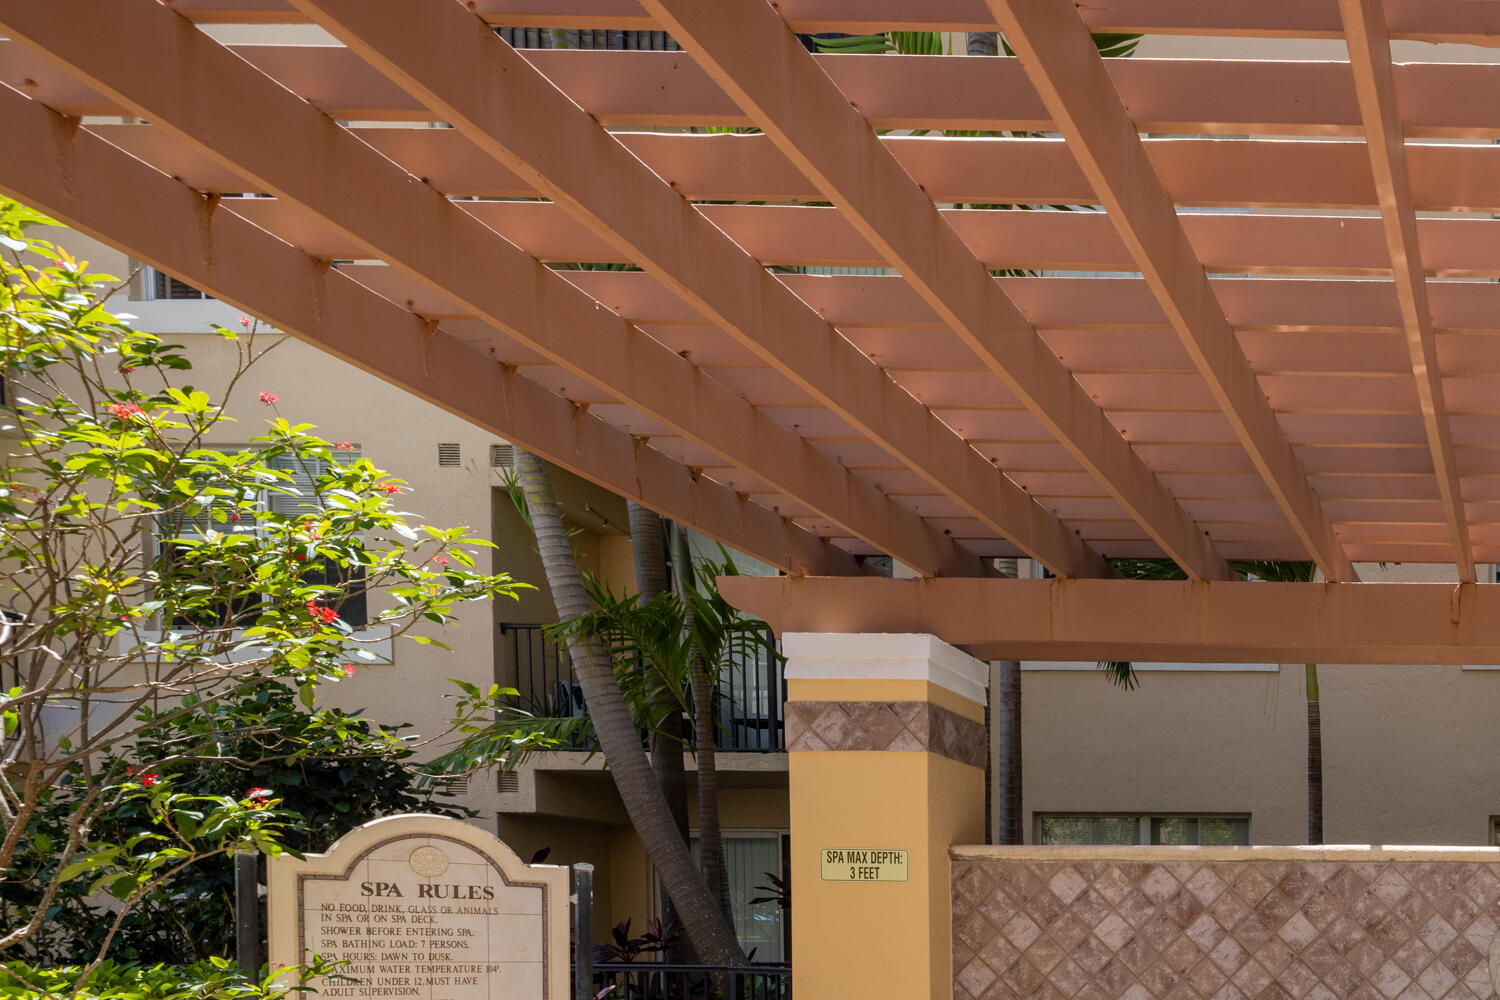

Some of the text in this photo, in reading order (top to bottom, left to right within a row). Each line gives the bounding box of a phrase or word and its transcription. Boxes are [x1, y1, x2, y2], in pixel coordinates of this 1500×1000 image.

[826, 850, 902, 864] SPA MAX DEPTH:
[850, 866, 880, 880] 3 FEET
[361, 881, 494, 900] SPA RULES
[321, 903, 498, 915] NO FOOD, DRINK, GLASS OR ANIMALS
[321, 914, 438, 924] IN SPA OR ON SPA DECK.
[321, 926, 474, 936] SHOWER BEFORE ENTERING SPA.
[321, 940, 338, 948] SPA
[342, 940, 385, 948] BATHING
[390, 940, 417, 948] LOAD:
[430, 940, 470, 949] PERSONS.
[322, 965, 375, 973] AXIMUM
[380, 965, 411, 973] WATER
[415, 965, 482, 973] TEMPERATURE
[377, 978, 410, 986] UNDER
[426, 977, 450, 985] MUST
[454, 977, 478, 985] HAVE
[322, 987, 420, 996] ADULT SUPERVISION.
